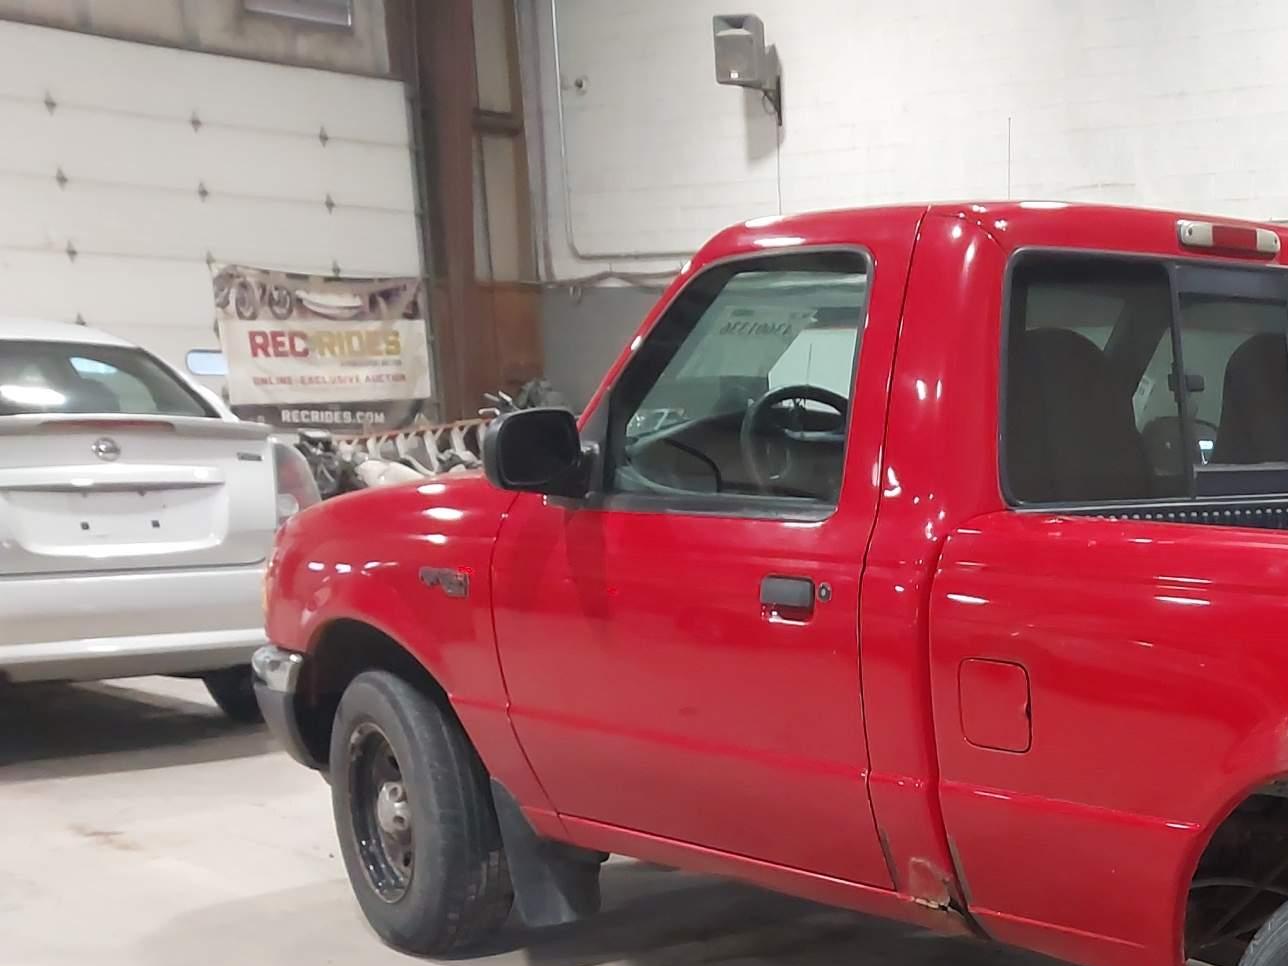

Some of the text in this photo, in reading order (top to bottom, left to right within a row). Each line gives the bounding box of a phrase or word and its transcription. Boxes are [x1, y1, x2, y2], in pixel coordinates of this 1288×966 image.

[248, 330, 401, 358] REC RIDES
[365, 373, 407, 384] AUCTION
[281, 408, 386, 424] RECRIDES.COM
